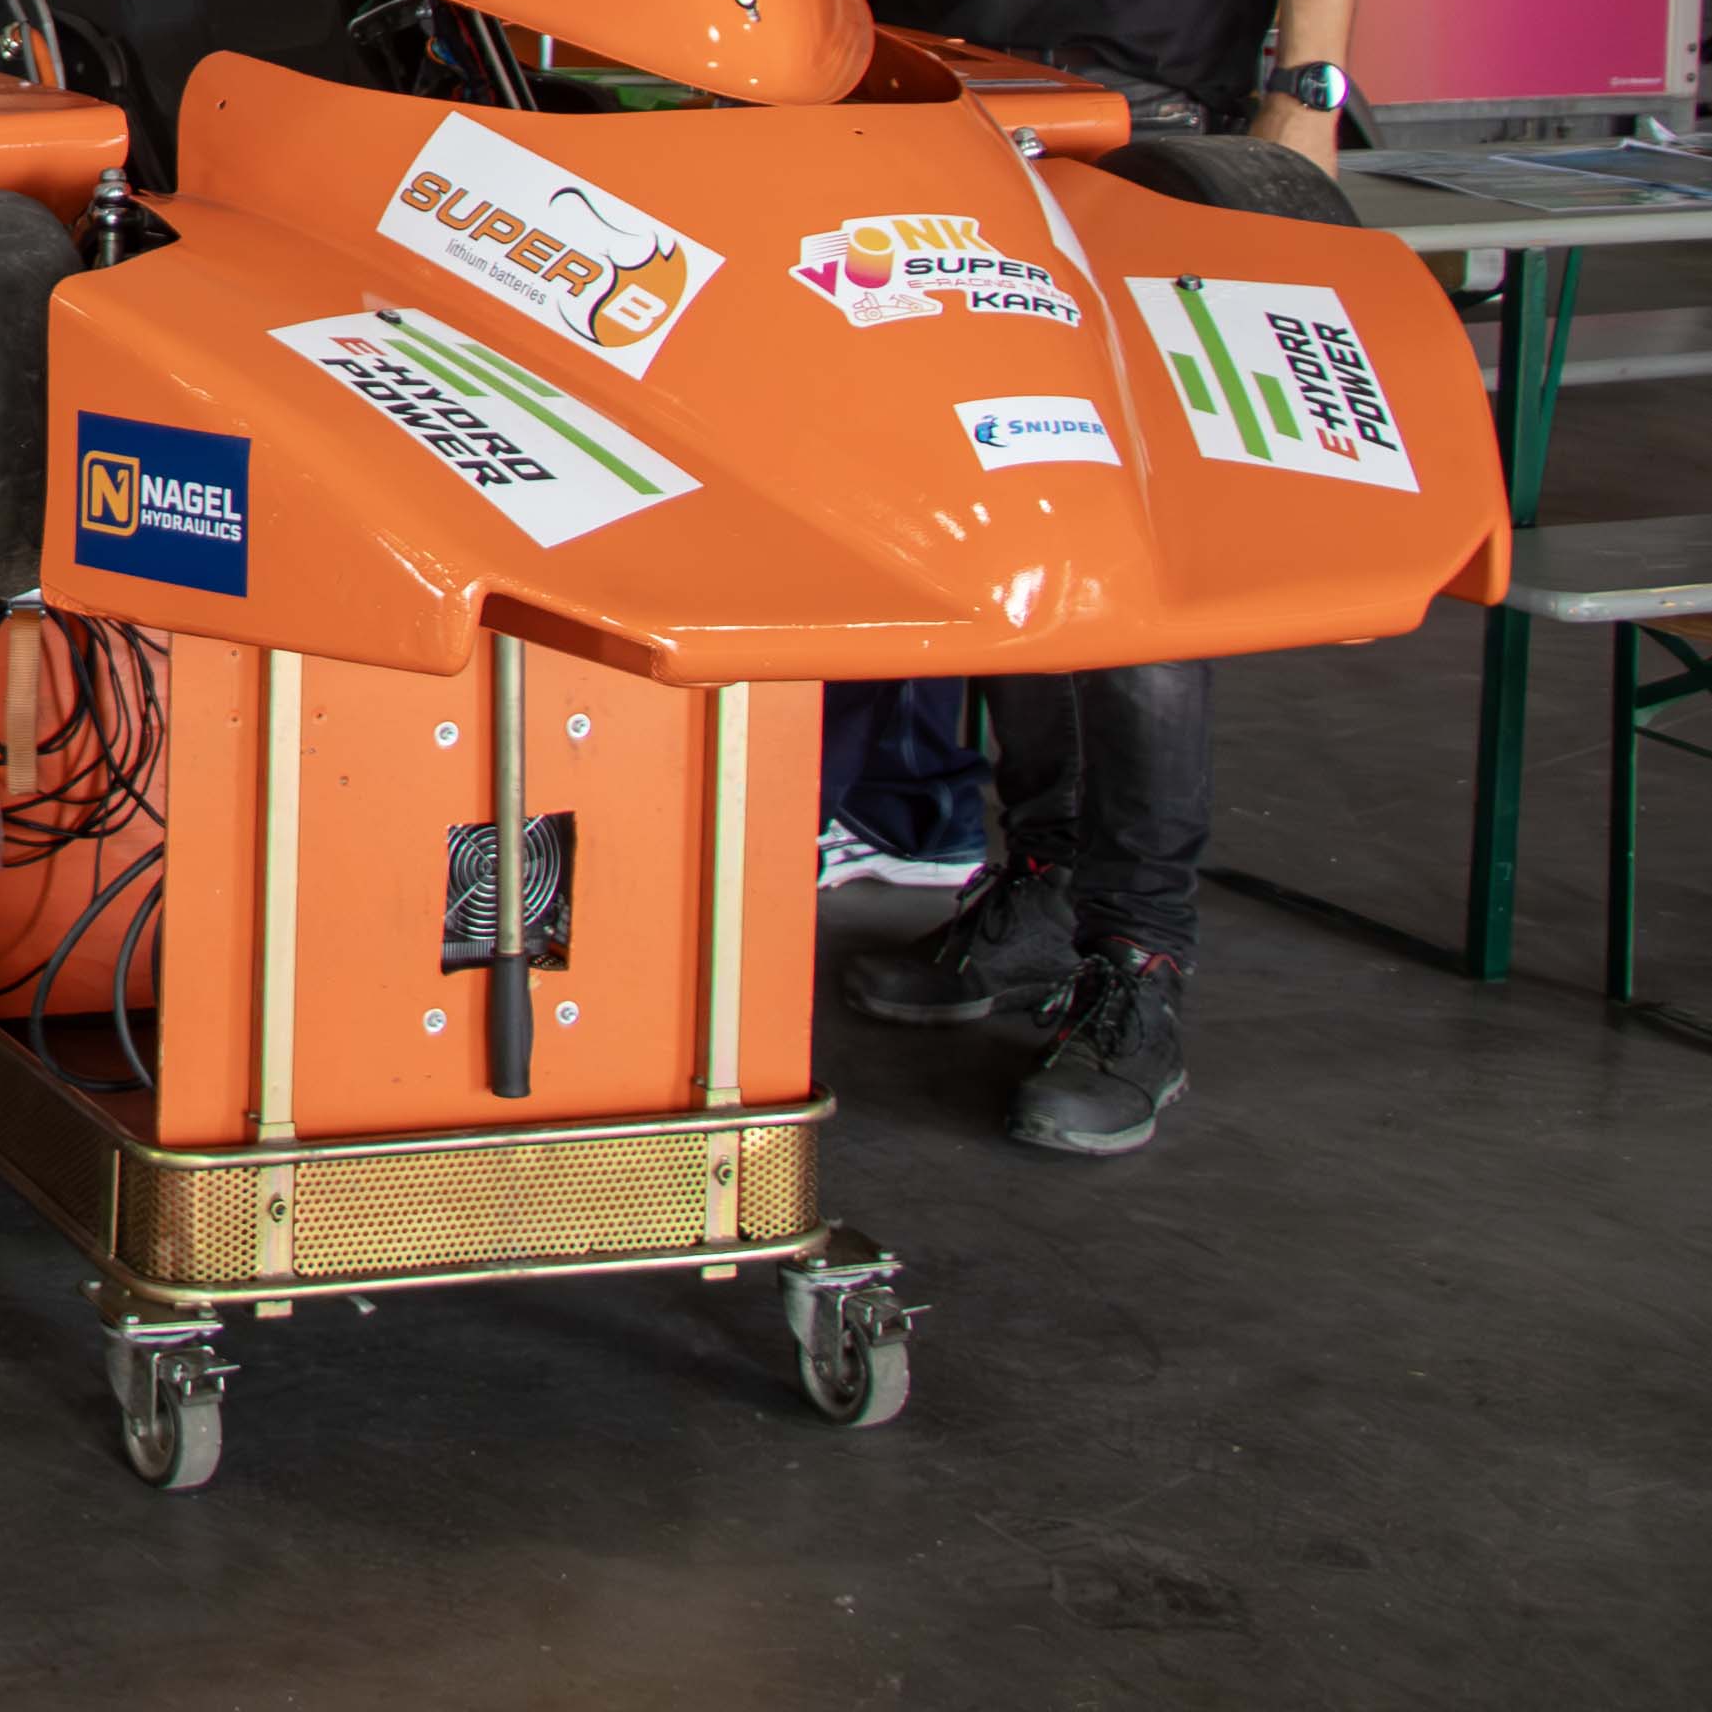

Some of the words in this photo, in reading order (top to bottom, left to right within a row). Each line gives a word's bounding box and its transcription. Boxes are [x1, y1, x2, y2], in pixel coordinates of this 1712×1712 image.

[400, 171, 604, 297] SUPER
[602, 283, 668, 333] B
[445, 238, 488, 273] lithium
[489, 263, 547, 306] batteries
[904, 257, 1052, 286] SUPER
[972, 290, 1080, 323] KART
[1312, 321, 1399, 451] POWER
[318, 358, 513, 488] POWER
[1007, 419, 1105, 436] SNIJDER
[141, 474, 242, 521] NAGEL
[141, 508, 242, 542] HYDRAULICS
